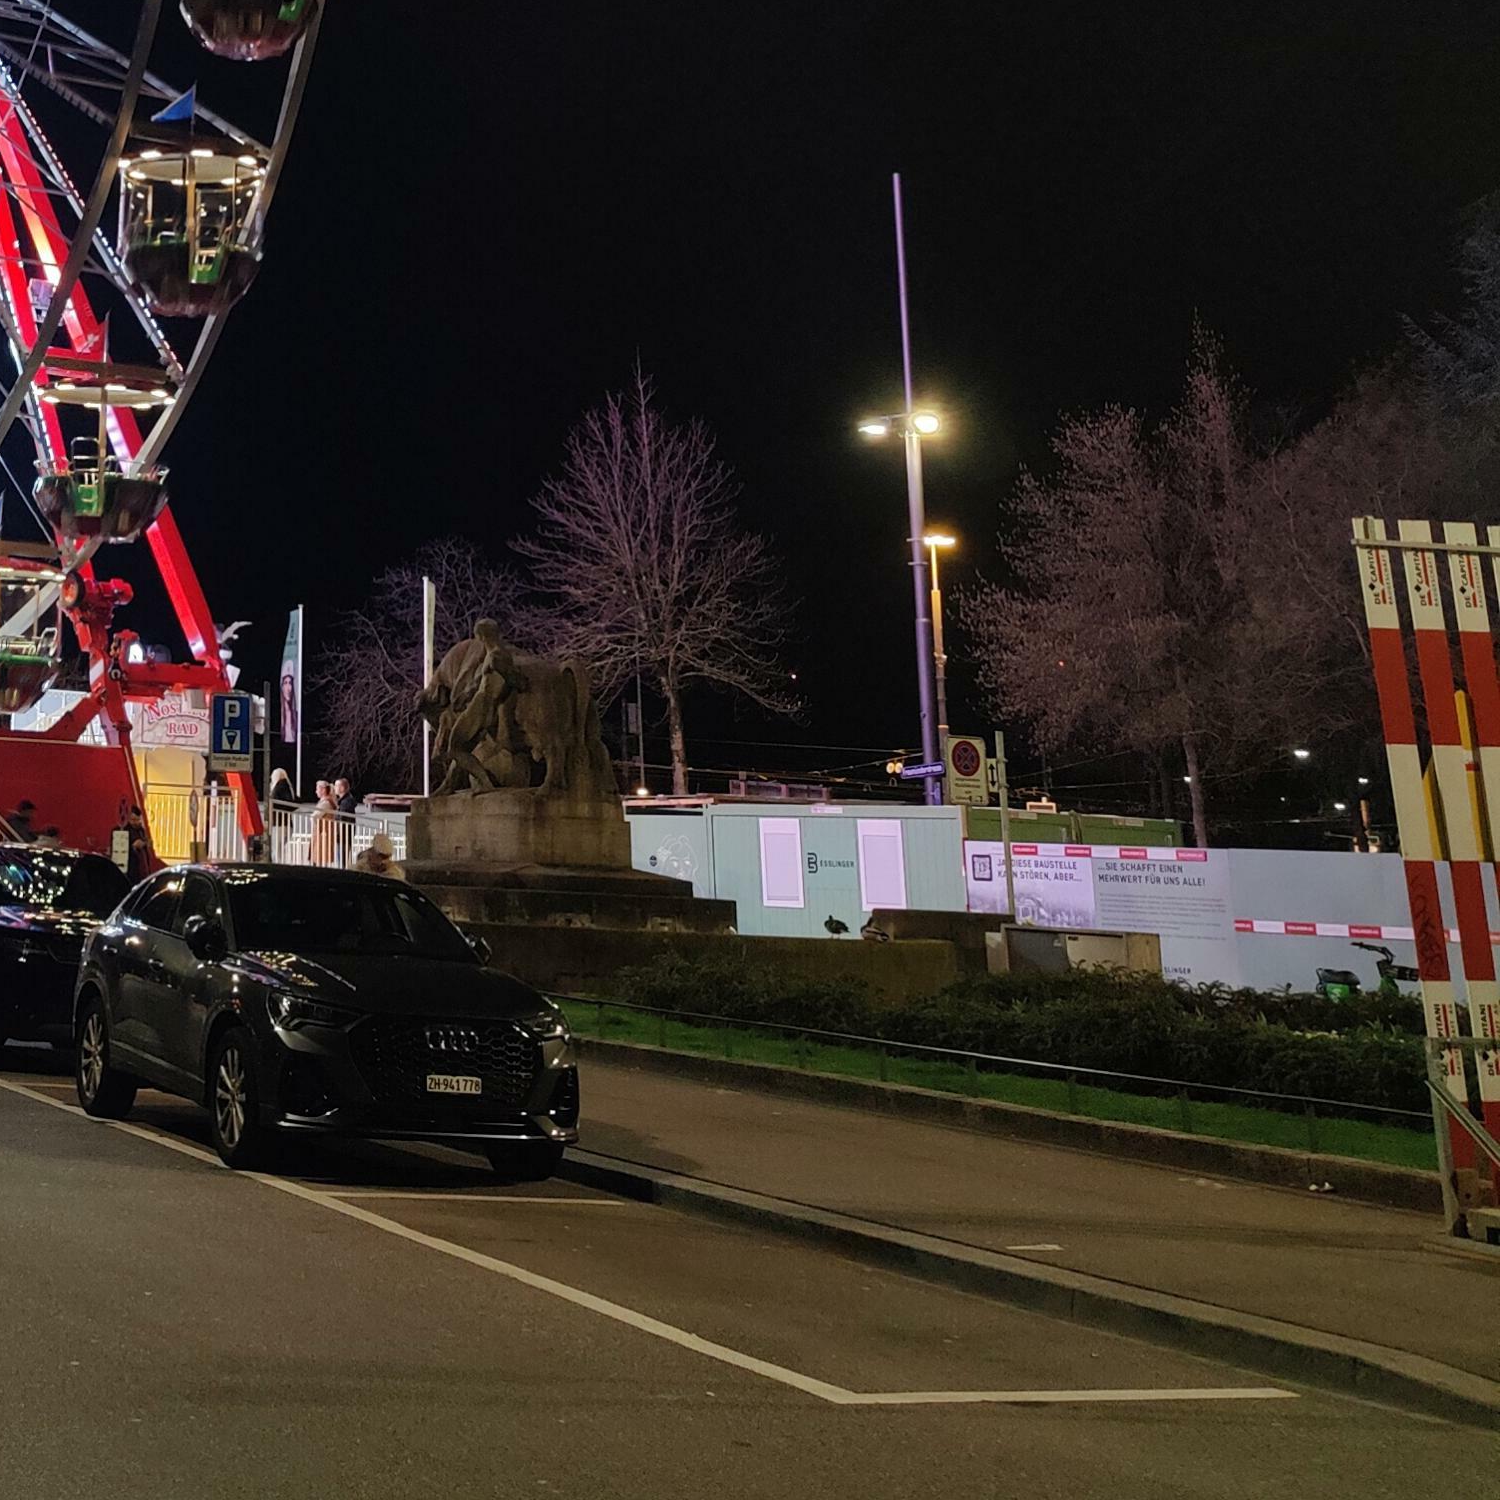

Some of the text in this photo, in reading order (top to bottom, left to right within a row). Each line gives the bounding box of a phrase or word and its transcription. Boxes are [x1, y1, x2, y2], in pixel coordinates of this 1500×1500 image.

[224, 700, 241, 728] P
[168, 722, 198, 735] RAD
[1034, 859, 1077, 870] BAUSTELLE
[1120, 862, 1156, 872] SCHAFFT
[1159, 864, 1183, 873] EINEN
[1098, 874, 1142, 884] MEHRWERT
[1145, 873, 1161, 884] FÜR
[1163, 877, 1180, 886] UNS
